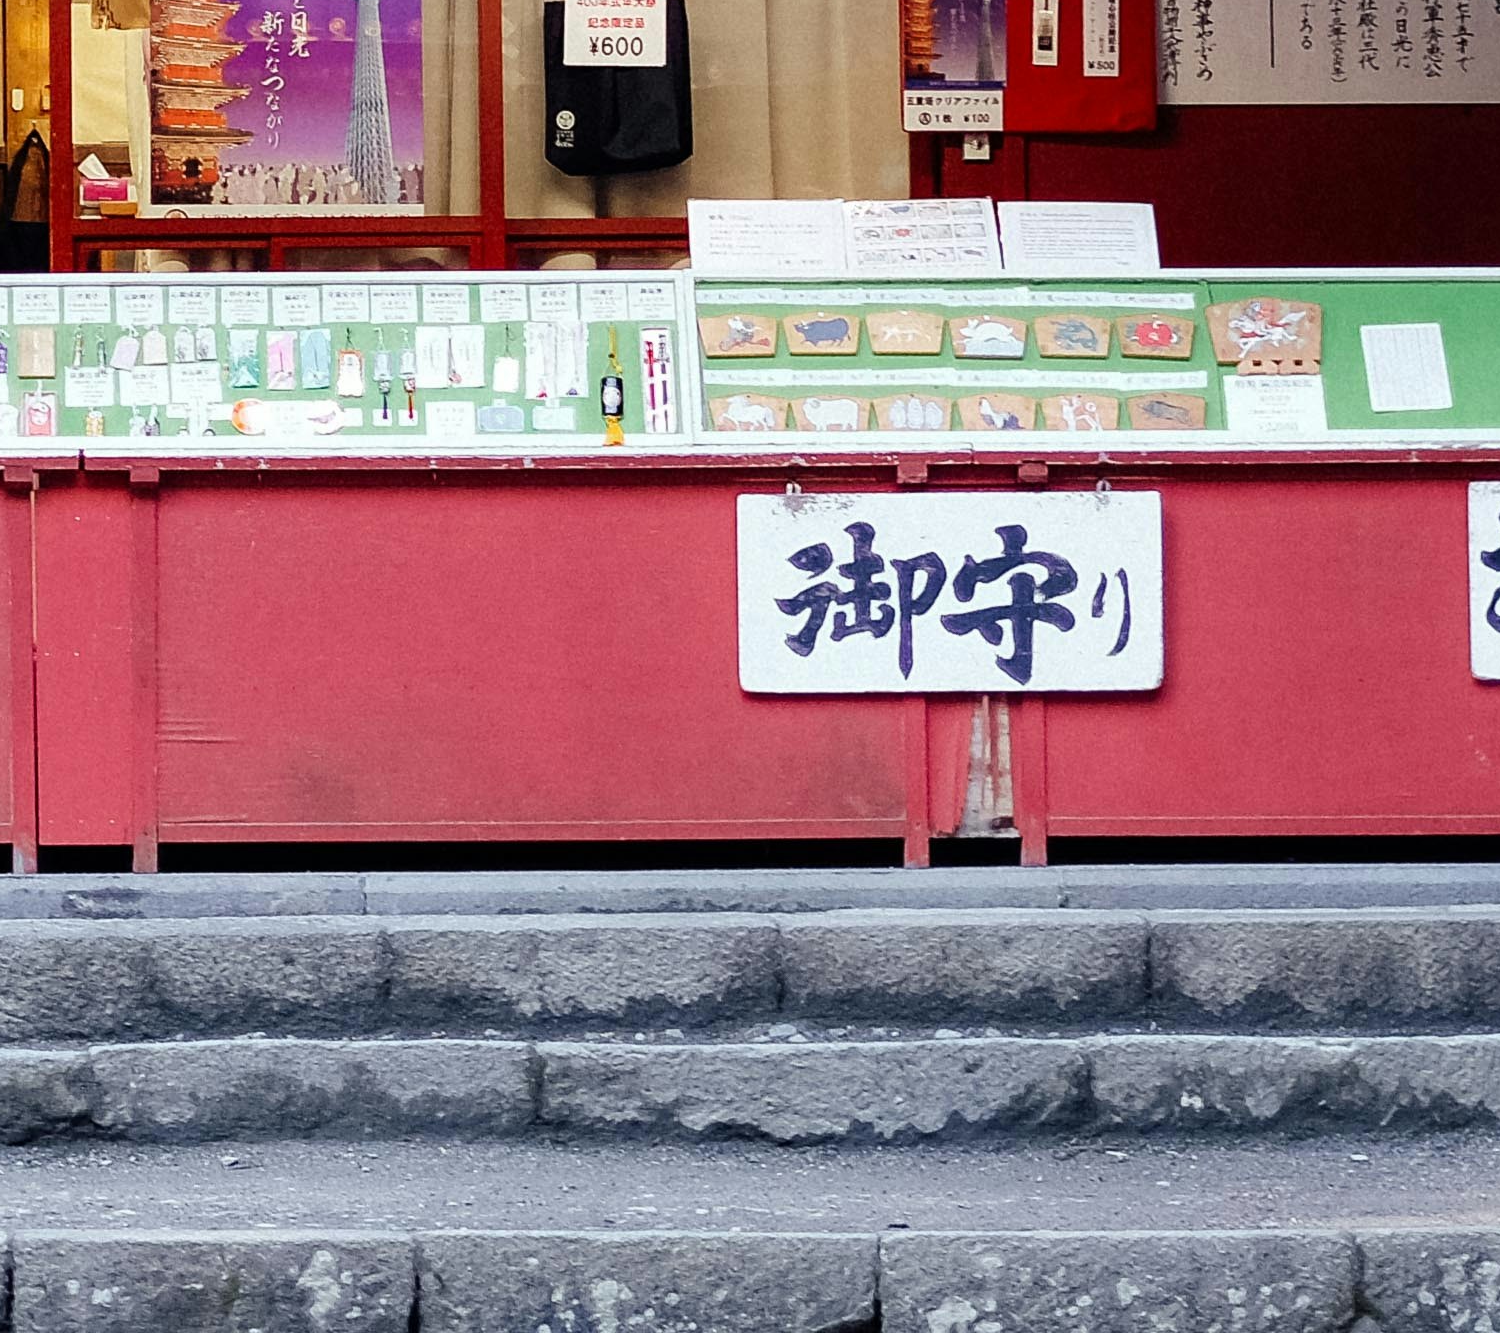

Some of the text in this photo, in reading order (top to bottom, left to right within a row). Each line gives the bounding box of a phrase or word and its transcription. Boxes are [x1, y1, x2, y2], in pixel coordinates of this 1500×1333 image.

[259, 9, 286, 150] 新たなつながり
[588, 36, 645, 57] ¥600
[773, 520, 1133, 686] 御守り
